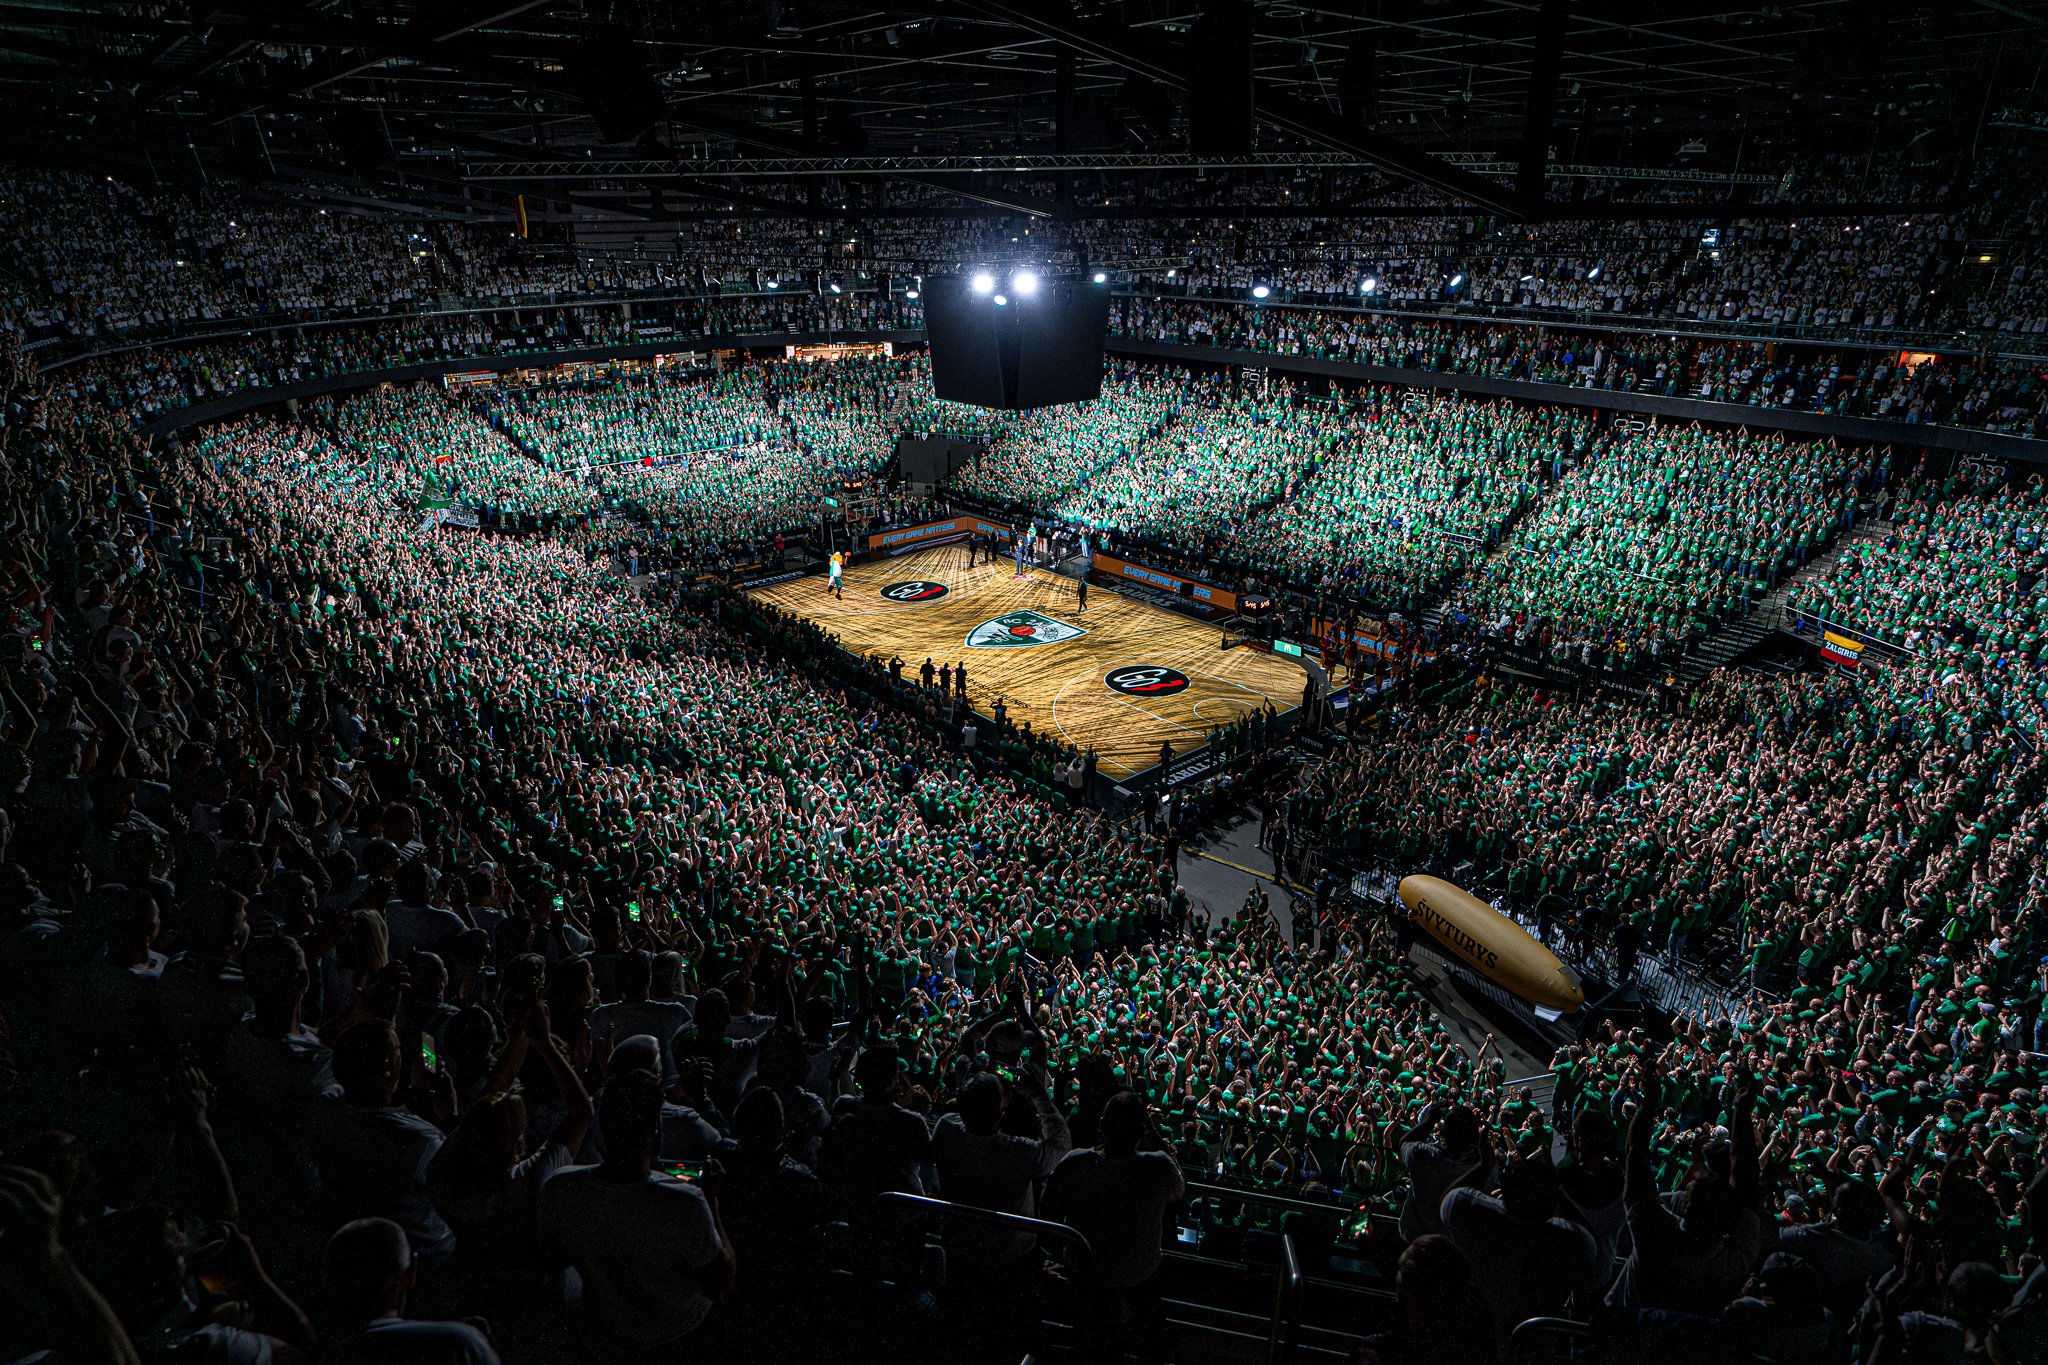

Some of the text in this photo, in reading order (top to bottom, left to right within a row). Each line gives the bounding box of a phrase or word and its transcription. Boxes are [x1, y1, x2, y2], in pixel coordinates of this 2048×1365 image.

[882, 532, 905, 545] EVERY
[905, 527, 925, 541] GAME
[925, 522, 956, 537] MATTERS
[1123, 565, 1149, 581] EVERY
[1149, 572, 1172, 587] GAME
[1415, 897, 1499, 970] ŠVYTURYS
